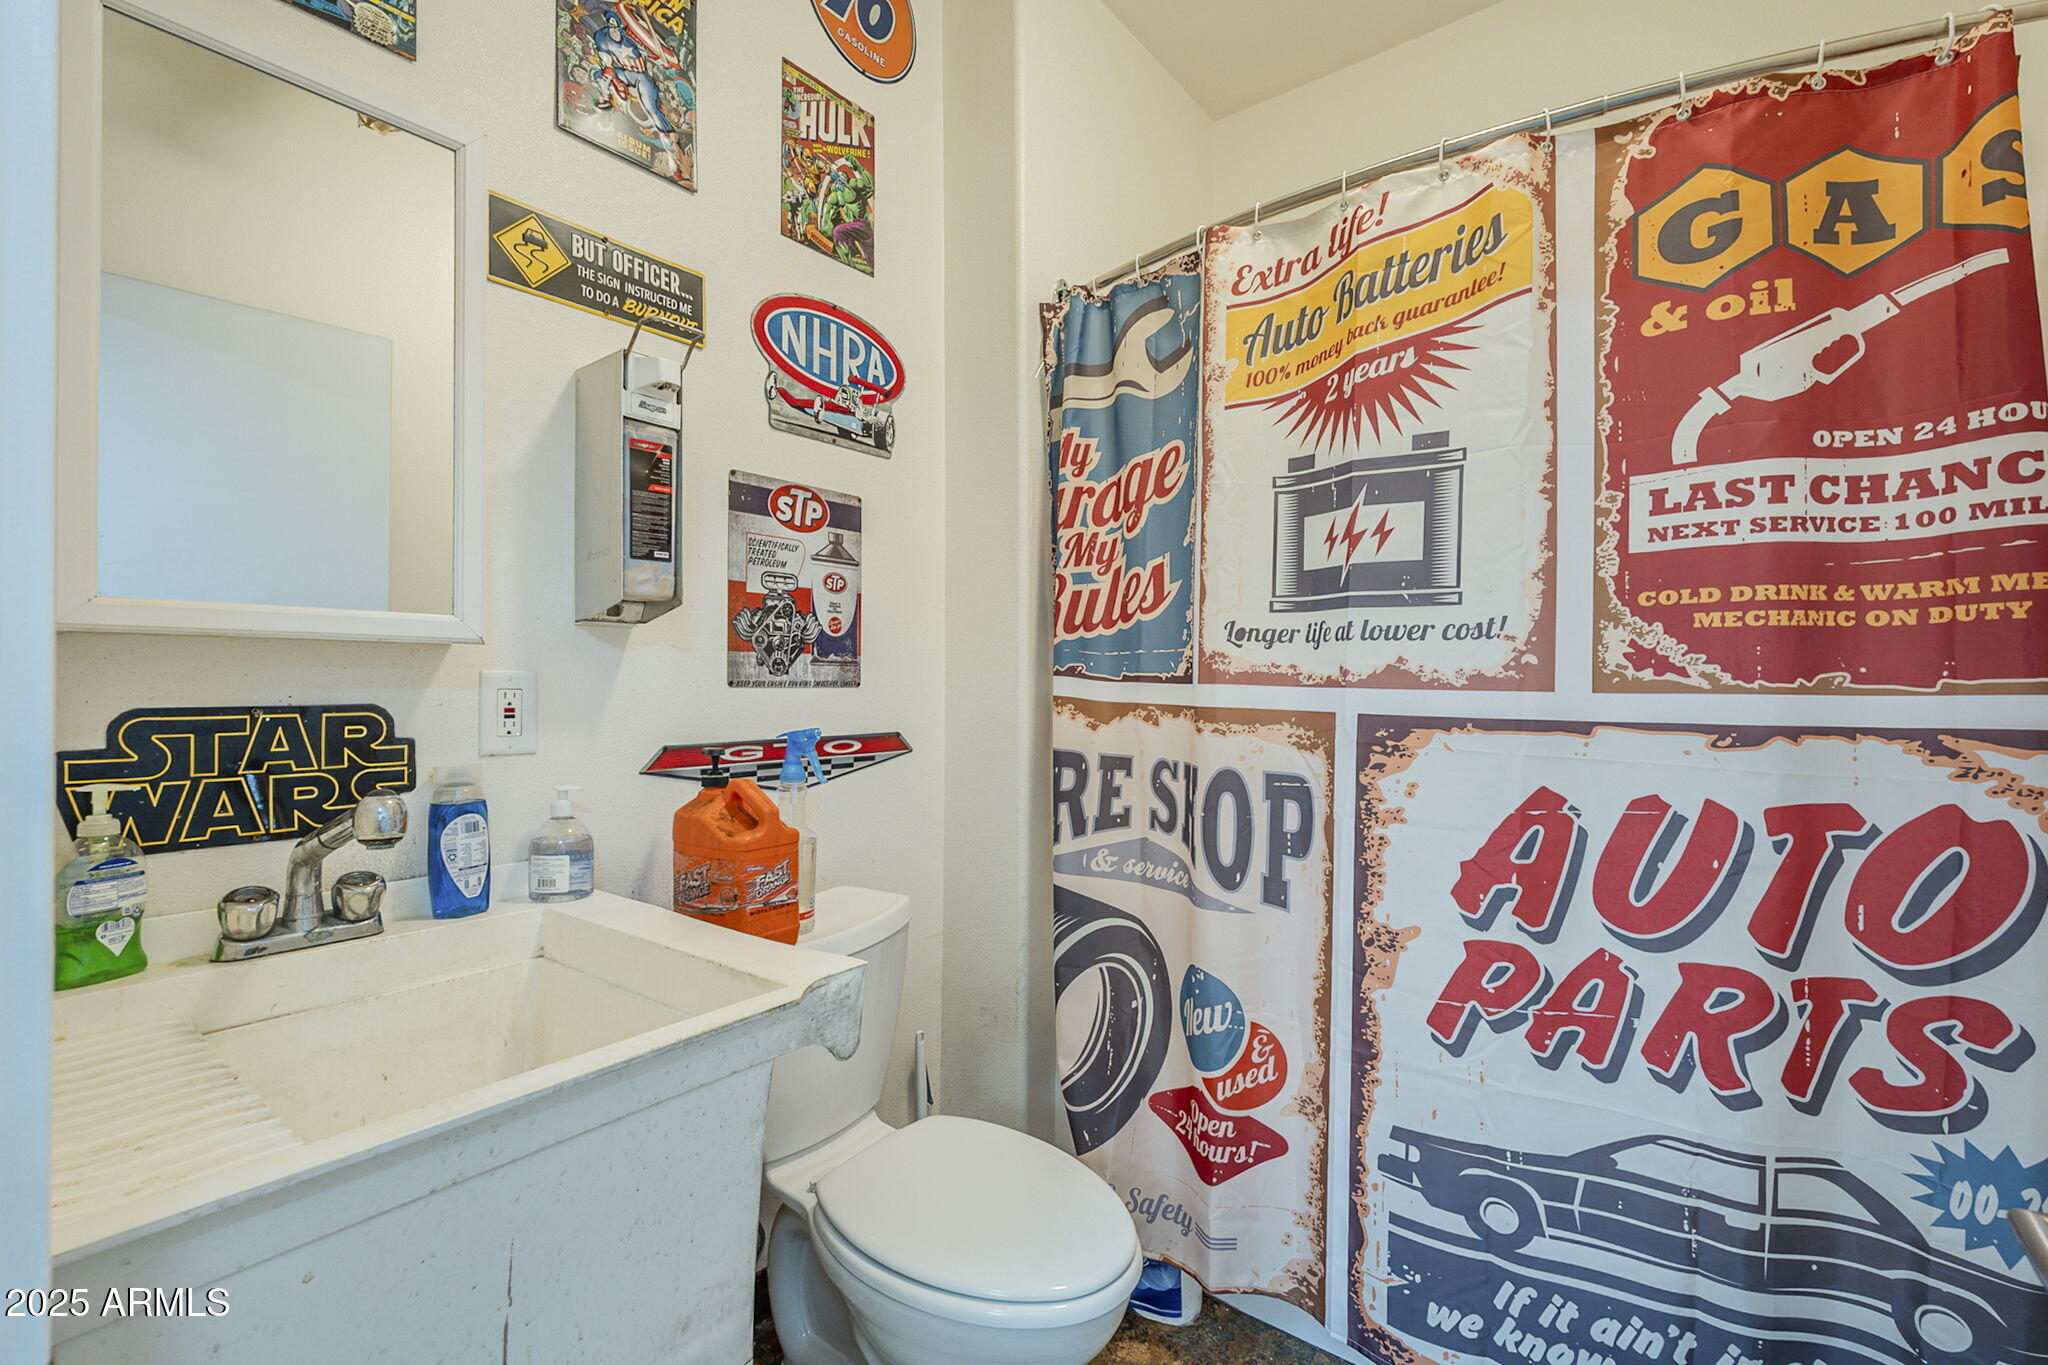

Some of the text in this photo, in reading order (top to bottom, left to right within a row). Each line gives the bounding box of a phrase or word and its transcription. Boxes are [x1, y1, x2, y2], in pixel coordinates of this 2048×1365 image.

[836, 27, 886, 67] GASOLINE
[617, 131, 652, 153] ALBUM
[799, 101, 872, 148] HULK
[826, 145, 871, 159] WOLVERINE!
[1231, 190, 1390, 297] Extra life!
[571, 233, 694, 302] BUT OFFICER...
[1242, 212, 1508, 367] Auto Batteries
[577, 264, 693, 317] THE SIGN INSTRUCTED ME
[581, 285, 594, 299] TO
[596, 289, 610, 305] DO
[612, 294, 620, 308] A
[1640, 277, 1797, 337] & oil
[1245, 261, 1507, 389] 100% money back guarantee!
[781, 314, 887, 388] NHRA
[1325, 346, 1419, 405] 2 years
[1812, 401, 2048, 449] OPEN 24 HOU
[1057, 445, 1183, 534] rage
[1648, 450, 2046, 518] LAST CHANC
[776, 487, 824, 527] STP
[1647, 519, 1741, 543] NEXT
[1894, 506, 1957, 530] 100
[1968, 496, 2048, 521] MIL
[747, 537, 800, 553] SCIENTIFICALLY
[748, 547, 778, 559] TREATED
[748, 556, 788, 568] PETROLEUM
[1064, 531, 1120, 576] My
[825, 575, 845, 591] STP
[1637, 571, 2048, 607] COLD DRINK & WARM ME
[1224, 615, 1508, 651] Longer life at lower cost!
[1692, 600, 2033, 629] MECHANIC ON DUTY
[64, 712, 409, 784] STAR
[720, 739, 863, 761] GO
[1053, 747, 1134, 846] RE
[680, 863, 712, 886] FAST
[755, 858, 791, 888] FAST
[755, 872, 791, 899] ORANGE
[1090, 848, 1190, 888] & service
[1451, 785, 2048, 988] AUTO
[1184, 998, 1233, 1036] New
[1426, 938, 2036, 1136] PARTS
[1252, 1035, 1274, 1064] &
[1216, 1055, 1279, 1101] used
[1175, 1109, 1259, 1163] 24 hours!
[1190, 1099, 1237, 1138] Open
[1125, 1187, 1194, 1237] Safety
[1426, 1301, 1485, 1339] we
[1493, 1280, 1538, 1318] If
[1538, 1293, 1580, 1334] it
[1590, 1315, 1698, 1365] ain't
